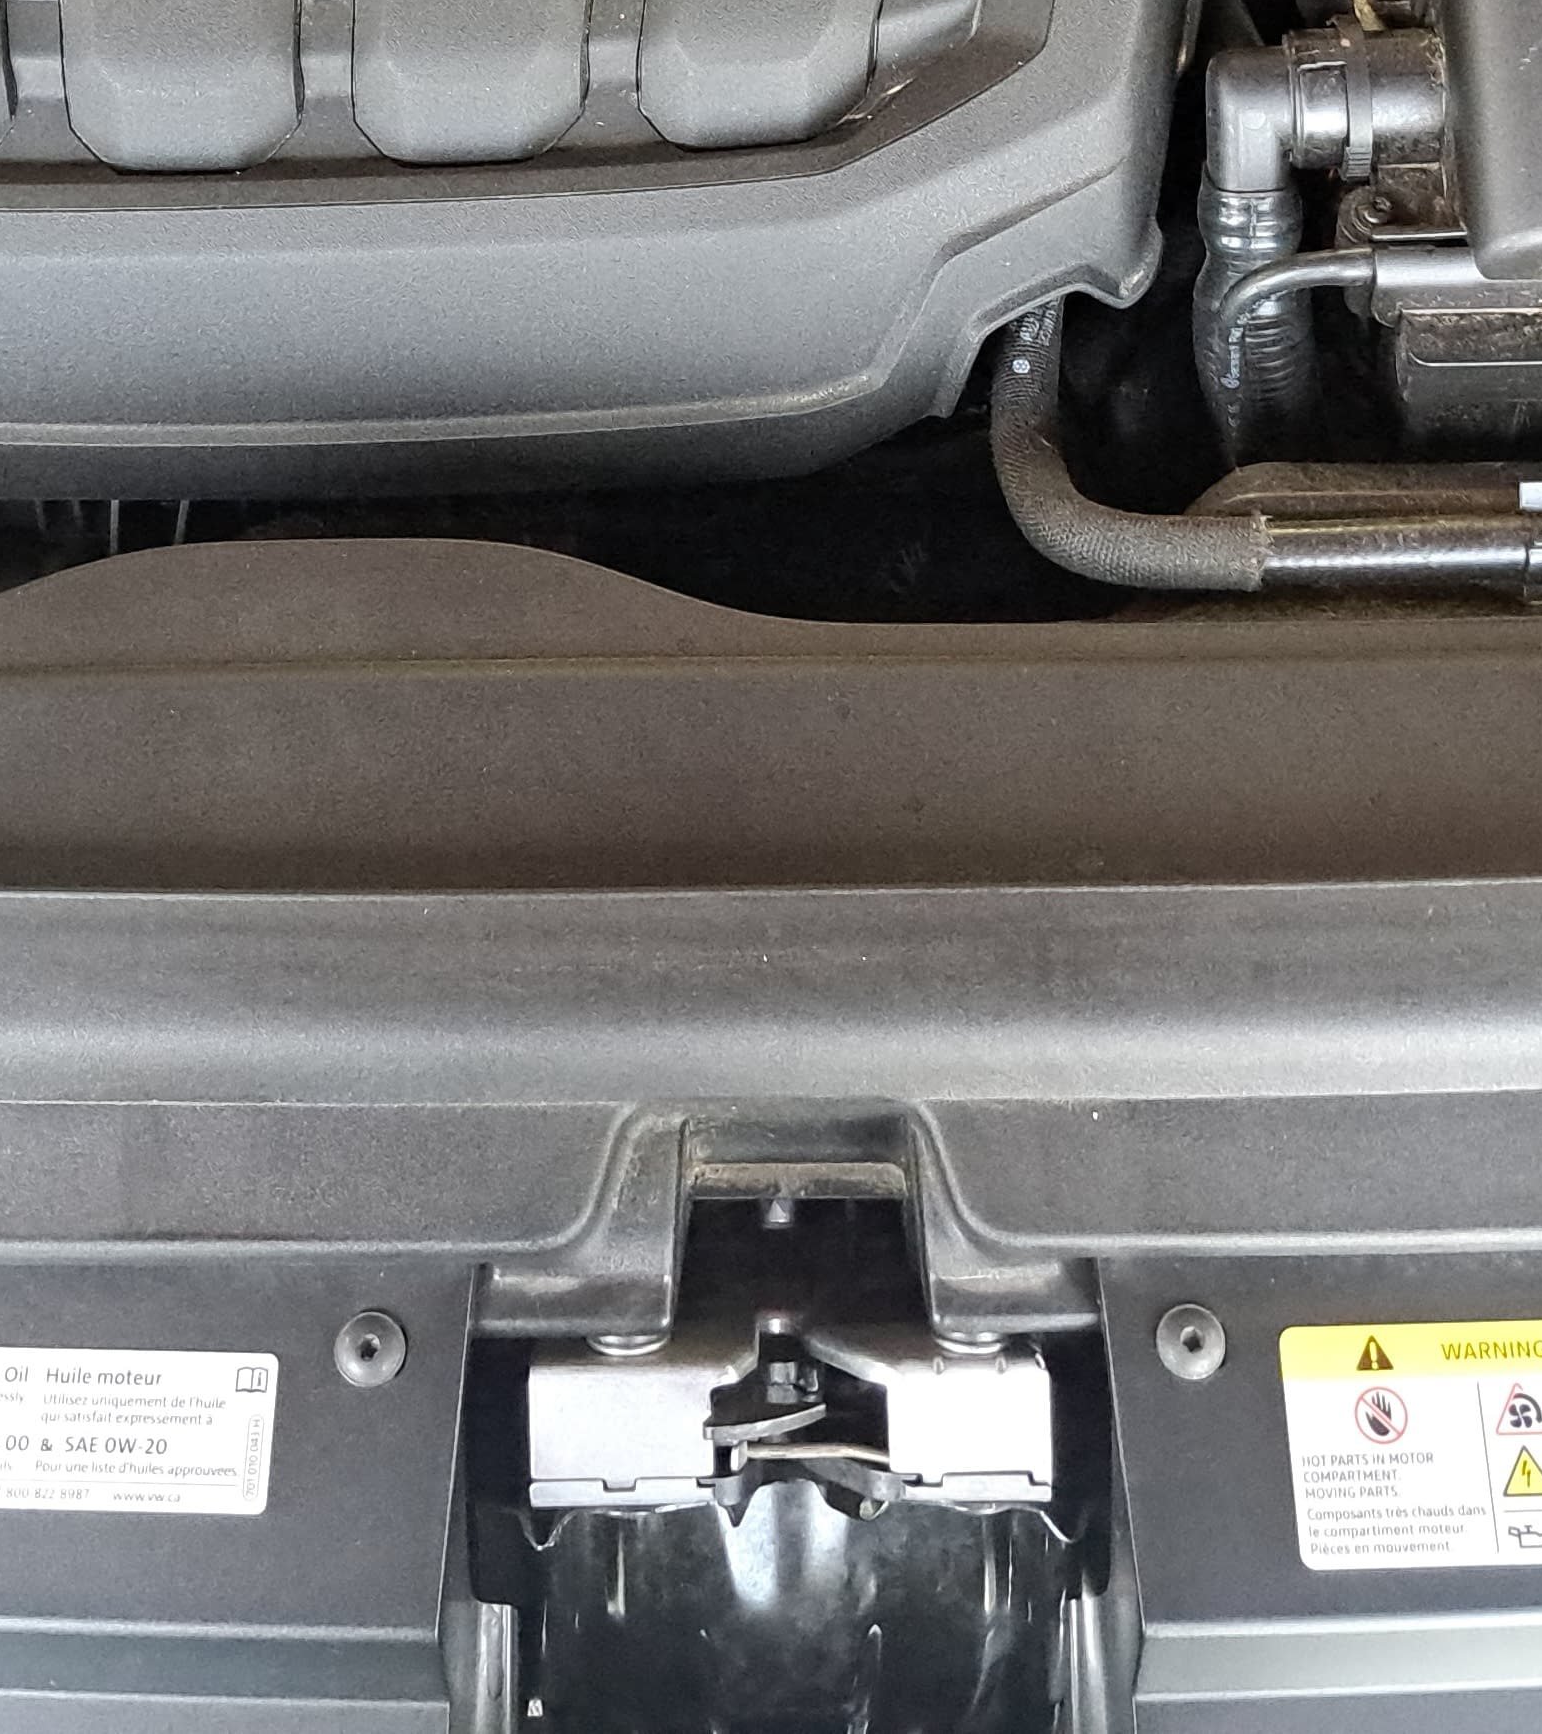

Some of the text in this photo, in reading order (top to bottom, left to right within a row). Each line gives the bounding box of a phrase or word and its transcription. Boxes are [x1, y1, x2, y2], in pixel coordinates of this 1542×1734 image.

[4, 1366, 29, 1383] Oil
[46, 1367, 162, 1386] Huile moteur
[43, 1394, 88, 1406] Utilisez
[91, 1396, 167, 1409] uniquement
[170, 1397, 185, 1408] de
[40, 1412, 60, 1425] qui
[64, 1411, 111, 1423] satisfait
[5, 1434, 30, 1451] 00
[40, 1437, 53, 1452] &
[65, 1436, 98, 1453] SAE
[104, 1437, 168, 1454] 0W-20
[36, 1460, 61, 1473] Pour
[65, 1463, 88, 1474] une
[91, 1462, 115, 1474] liste
[119, 1462, 164, 1475] d'huiles
[1301, 1452, 1434, 1467] HOT PARTS IN MOTOR
[1305, 1486, 1356, 1499] MOVING
[1307, 1504, 1487, 1523] Composants très chauds dans
[1309, 1525, 1321, 1538] le
[1323, 1524, 1416, 1542] compartiment
[1310, 1539, 1352, 1555] Pièces
[1355, 1543, 1369, 1554] en
